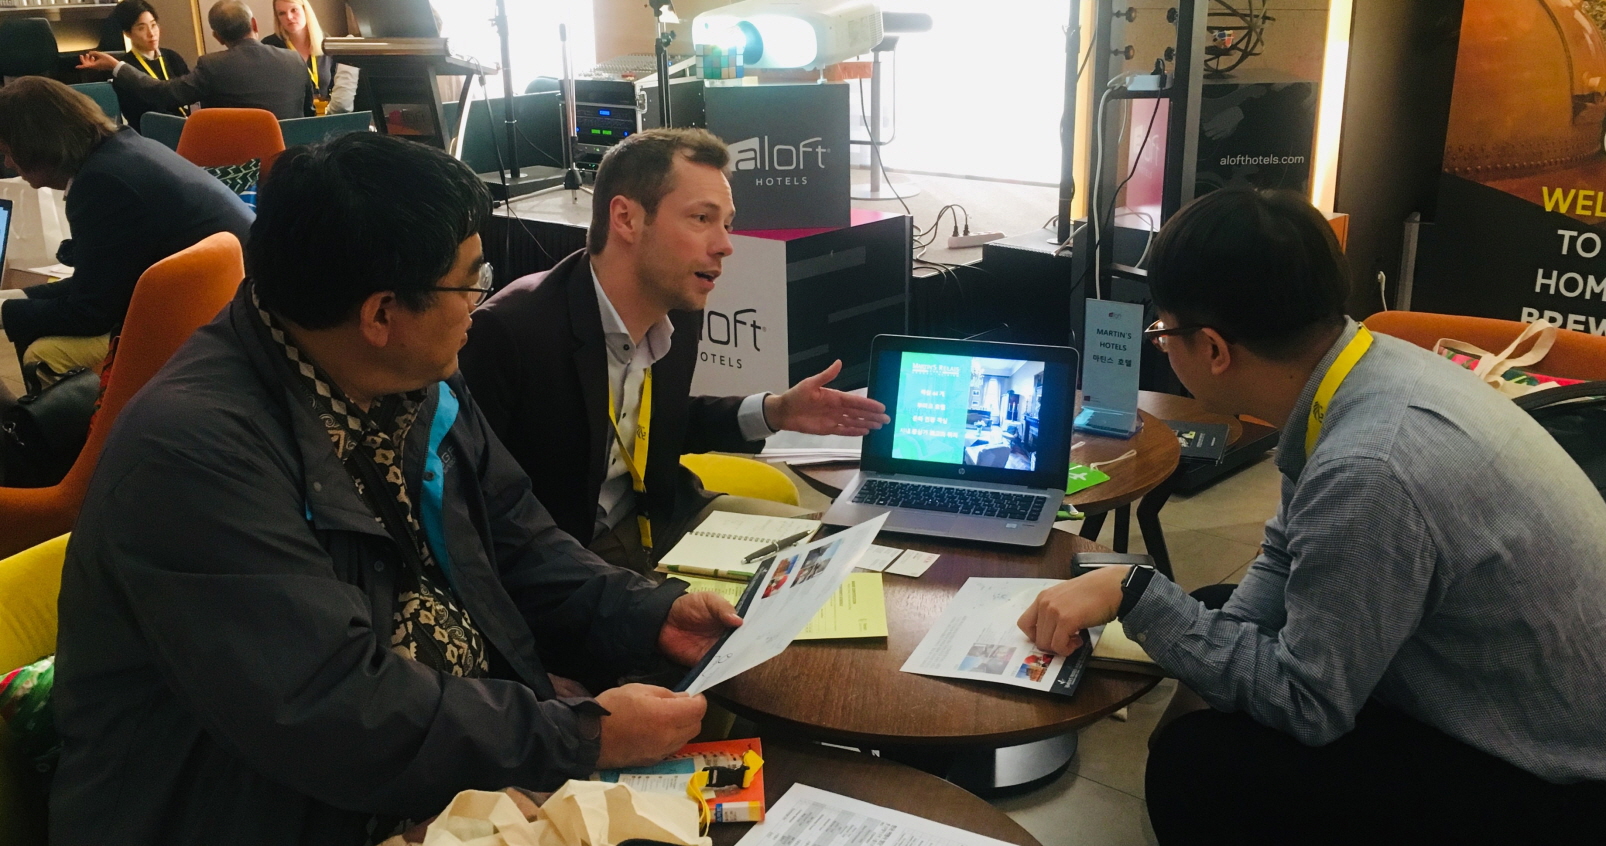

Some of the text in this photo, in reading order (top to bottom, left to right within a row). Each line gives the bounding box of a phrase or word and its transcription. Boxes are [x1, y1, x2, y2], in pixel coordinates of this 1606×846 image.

[734, 135, 827, 171] aloft
[1220, 154, 1305, 166] alofthotels.com
[755, 176, 808, 186] HOTELS
[1542, 186, 1606, 218] WEL
[1557, 229, 1602, 258] TO
[1535, 268, 1606, 302] HOM
[699, 308, 762, 352] oft
[1096, 328, 1132, 340] MARTIN'S
[1099, 341, 1127, 352] HOTELS
[700, 351, 743, 369] OTELS
[1117, 358, 1132, 367] 호텔
